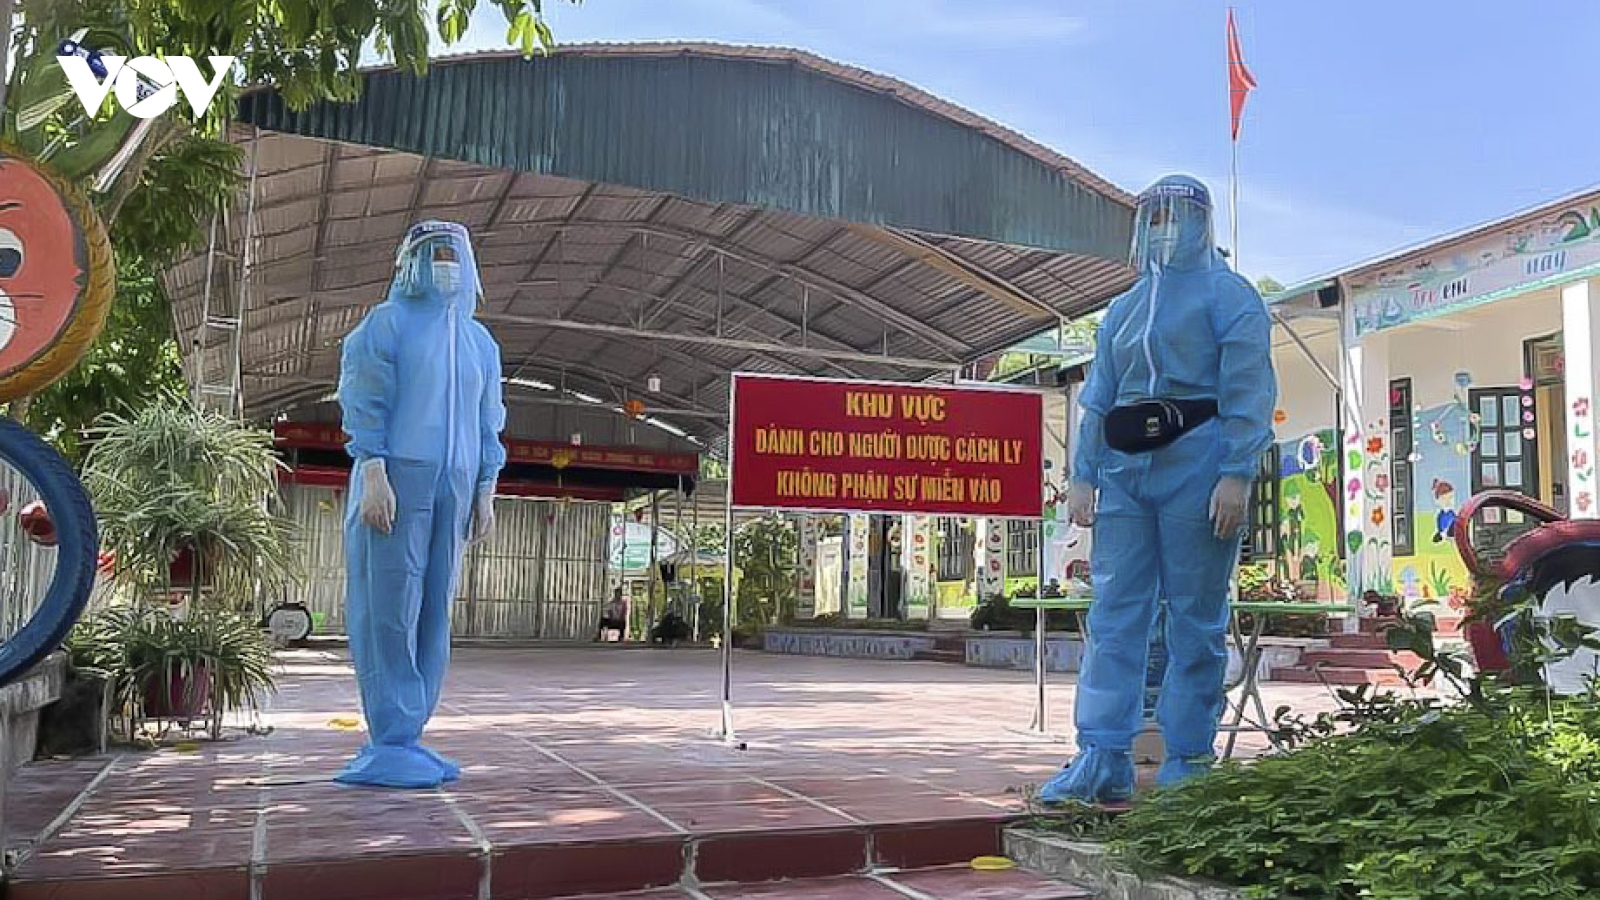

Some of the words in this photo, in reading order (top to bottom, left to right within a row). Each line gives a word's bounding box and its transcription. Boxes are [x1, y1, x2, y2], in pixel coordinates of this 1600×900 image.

[845, 391, 894, 418] KHU
[901, 393, 946, 426] VỰC
[809, 430, 844, 457] CHO
[1003, 439, 1023, 465] LY
[777, 466, 836, 498] KHÔNG
[841, 470, 889, 504] PHẬN
[894, 473, 918, 506] SỰ
